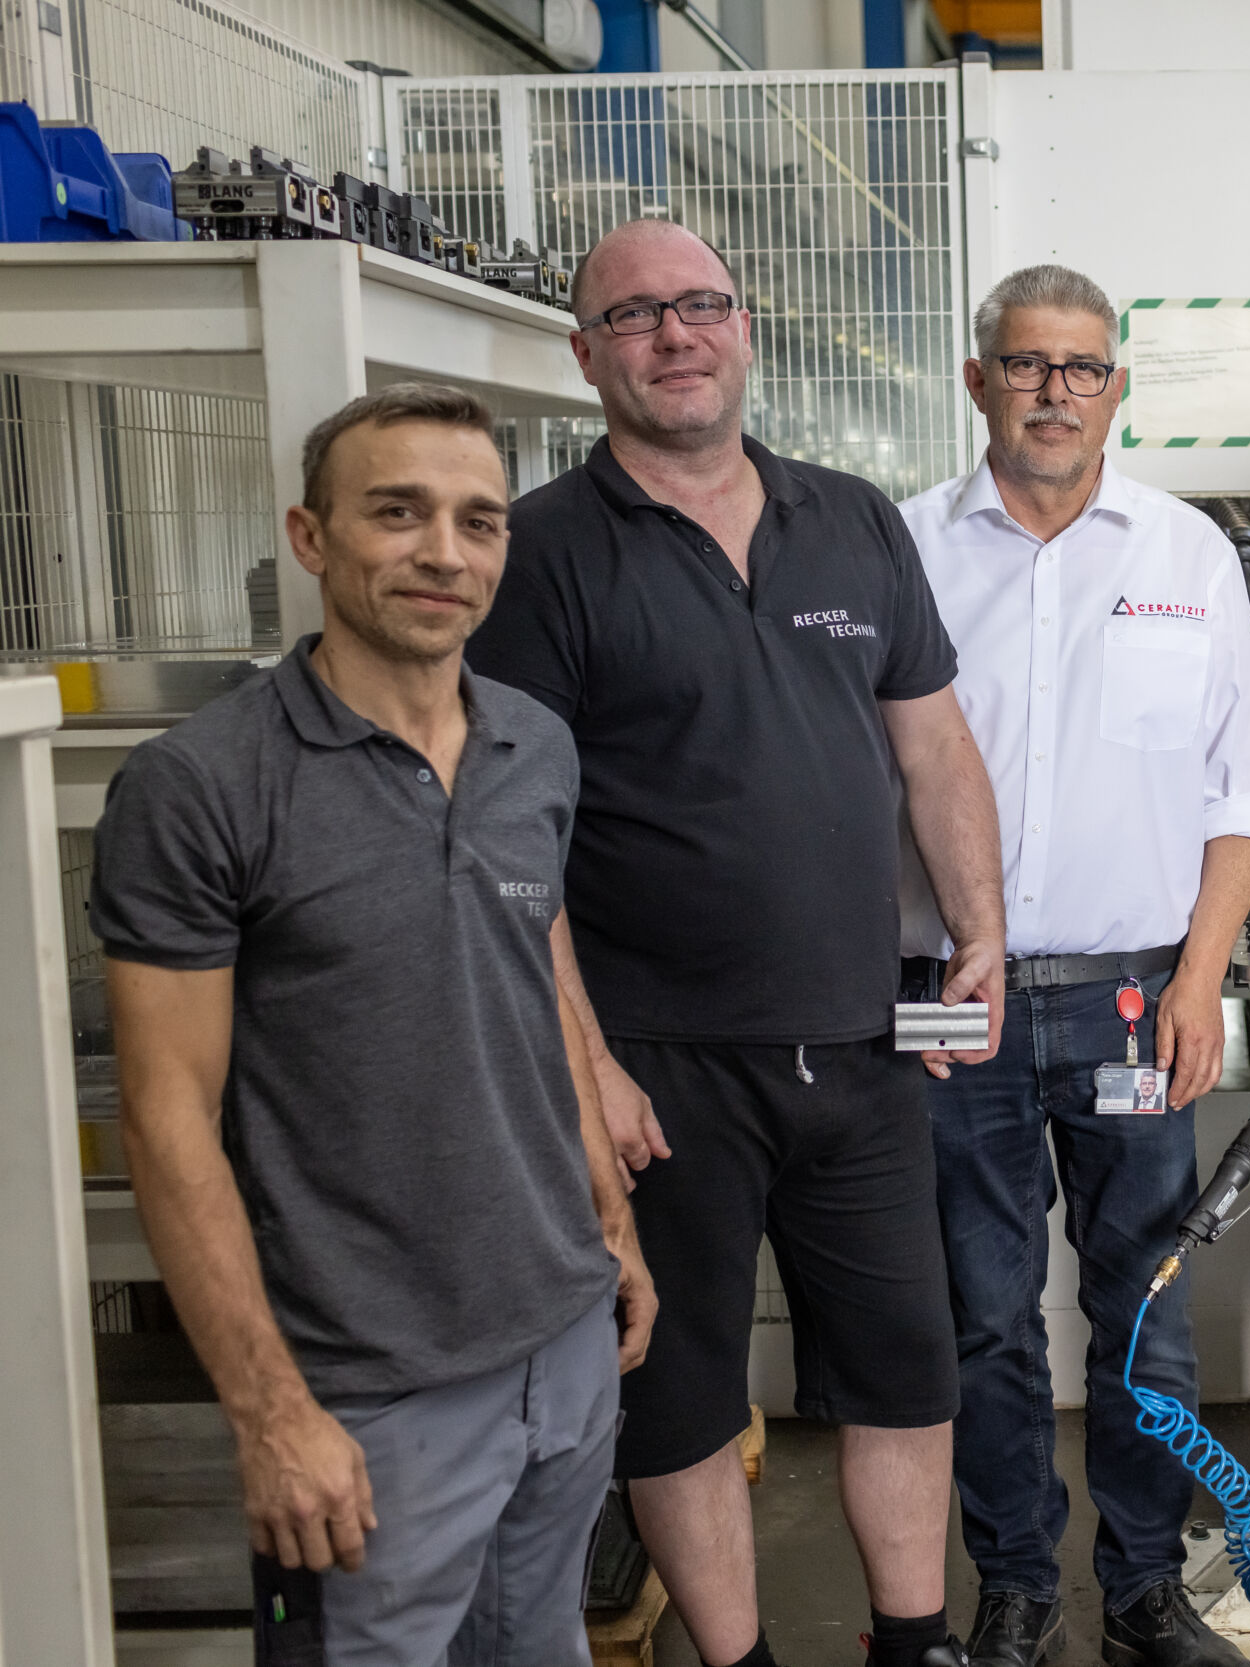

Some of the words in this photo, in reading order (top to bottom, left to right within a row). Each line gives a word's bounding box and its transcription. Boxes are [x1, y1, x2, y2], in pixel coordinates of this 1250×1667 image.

[212, 184, 254, 198] LANG
[486, 268, 517, 278] LANG
[1137, 603, 1206, 617] CERATIZIT
[793, 609, 850, 628] RECKER
[498, 882, 550, 898] RECKER
